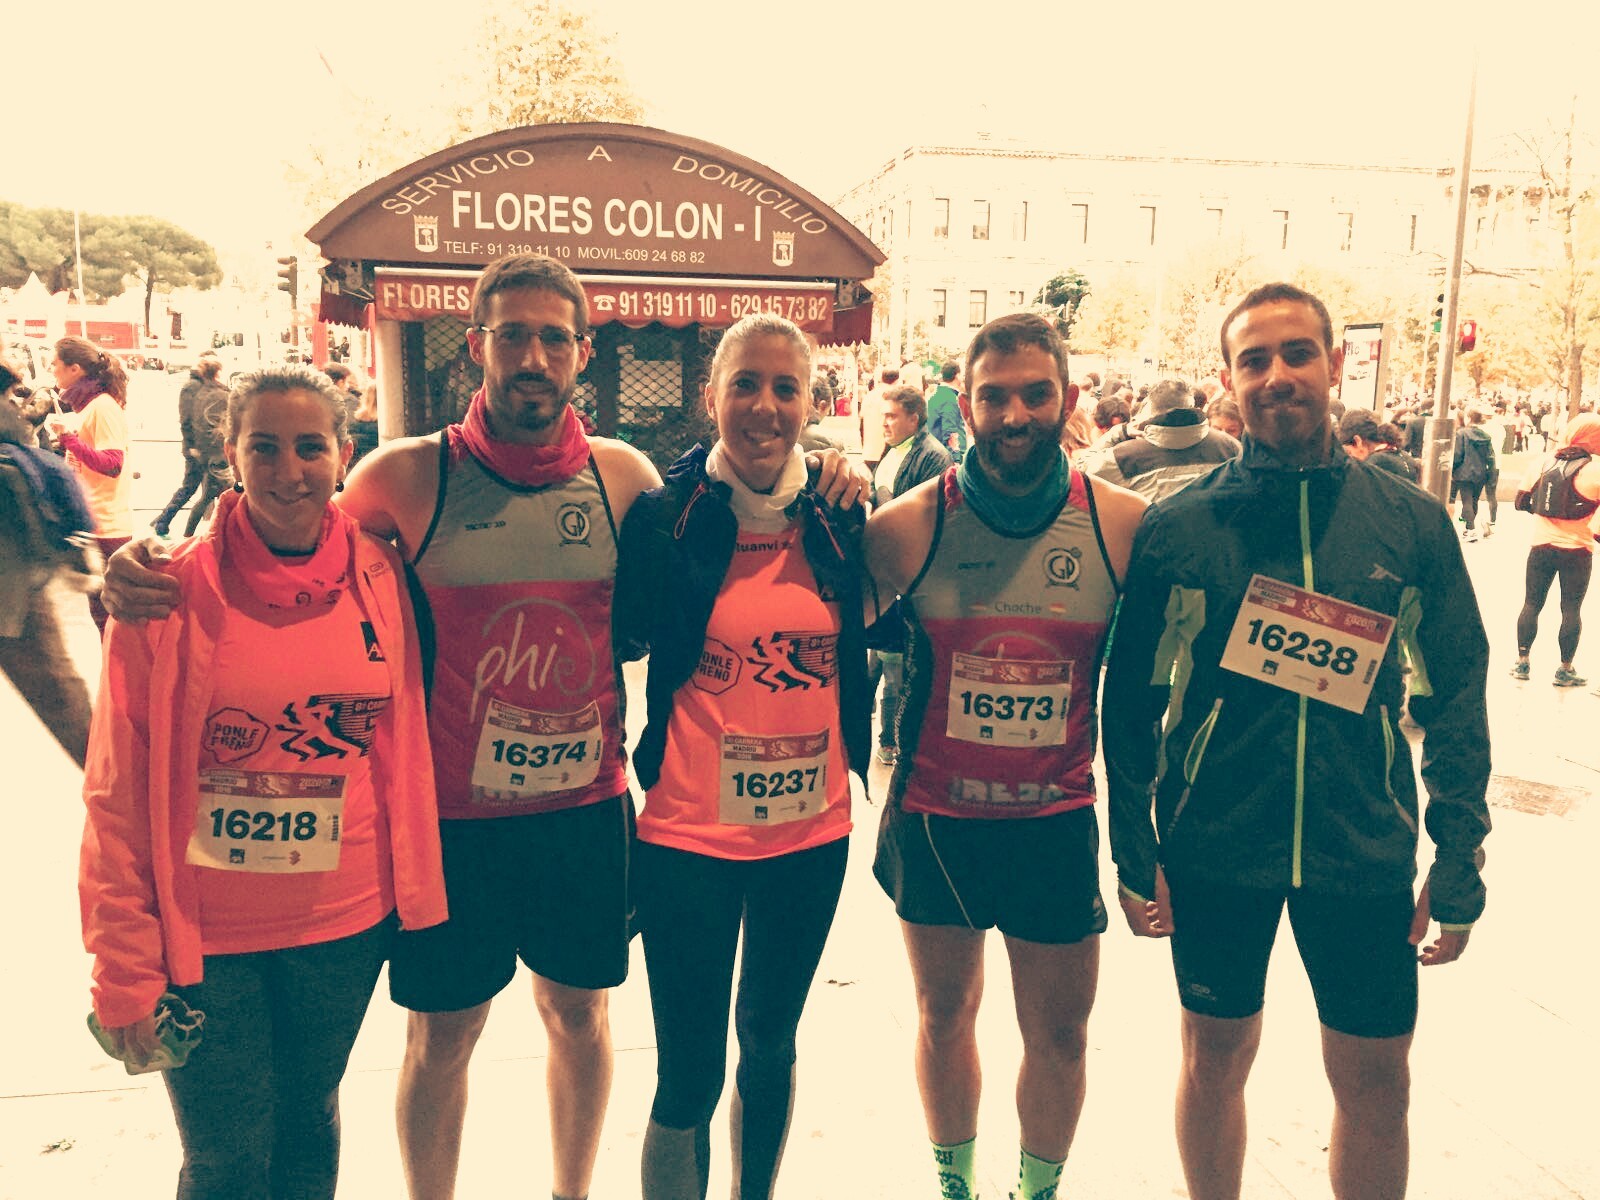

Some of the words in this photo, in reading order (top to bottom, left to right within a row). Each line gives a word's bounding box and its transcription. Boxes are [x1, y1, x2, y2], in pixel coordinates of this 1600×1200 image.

[381, 149, 535, 215] SERVICIO
[587, 144, 613, 162] A
[671, 155, 828, 234] DOMICILIO
[452, 190, 593, 235] FLORES
[604, 198, 723, 240] COLON
[443, 240, 485, 255] TELF:
[487, 243, 503, 255] 91
[536, 245, 550, 258] 11
[554, 246, 571, 259] 10
[651, 249, 668, 262] 24
[671, 250, 687, 263] 68
[689, 251, 705, 264] 82
[383, 282, 471, 311] FLORES
[618, 291, 639, 316] 91
[643, 291, 673, 317] 319
[675, 292, 693, 317] 11
[697, 293, 717, 318] 10
[731, 294, 762, 318] 629
[765, 295, 783, 318] 15
[786, 296, 805, 321] 73
[808, 297, 828, 321] 82
[701, 651, 733, 671] ONLE
[1247, 617, 1359, 677] 16238
[469, 610, 564, 724] phi
[698, 664, 730, 683] RENO
[961, 690, 1054, 721] 16373
[492, 739, 587, 769] 16374
[732, 765, 819, 799] 16237
[210, 807, 318, 842] 16218
